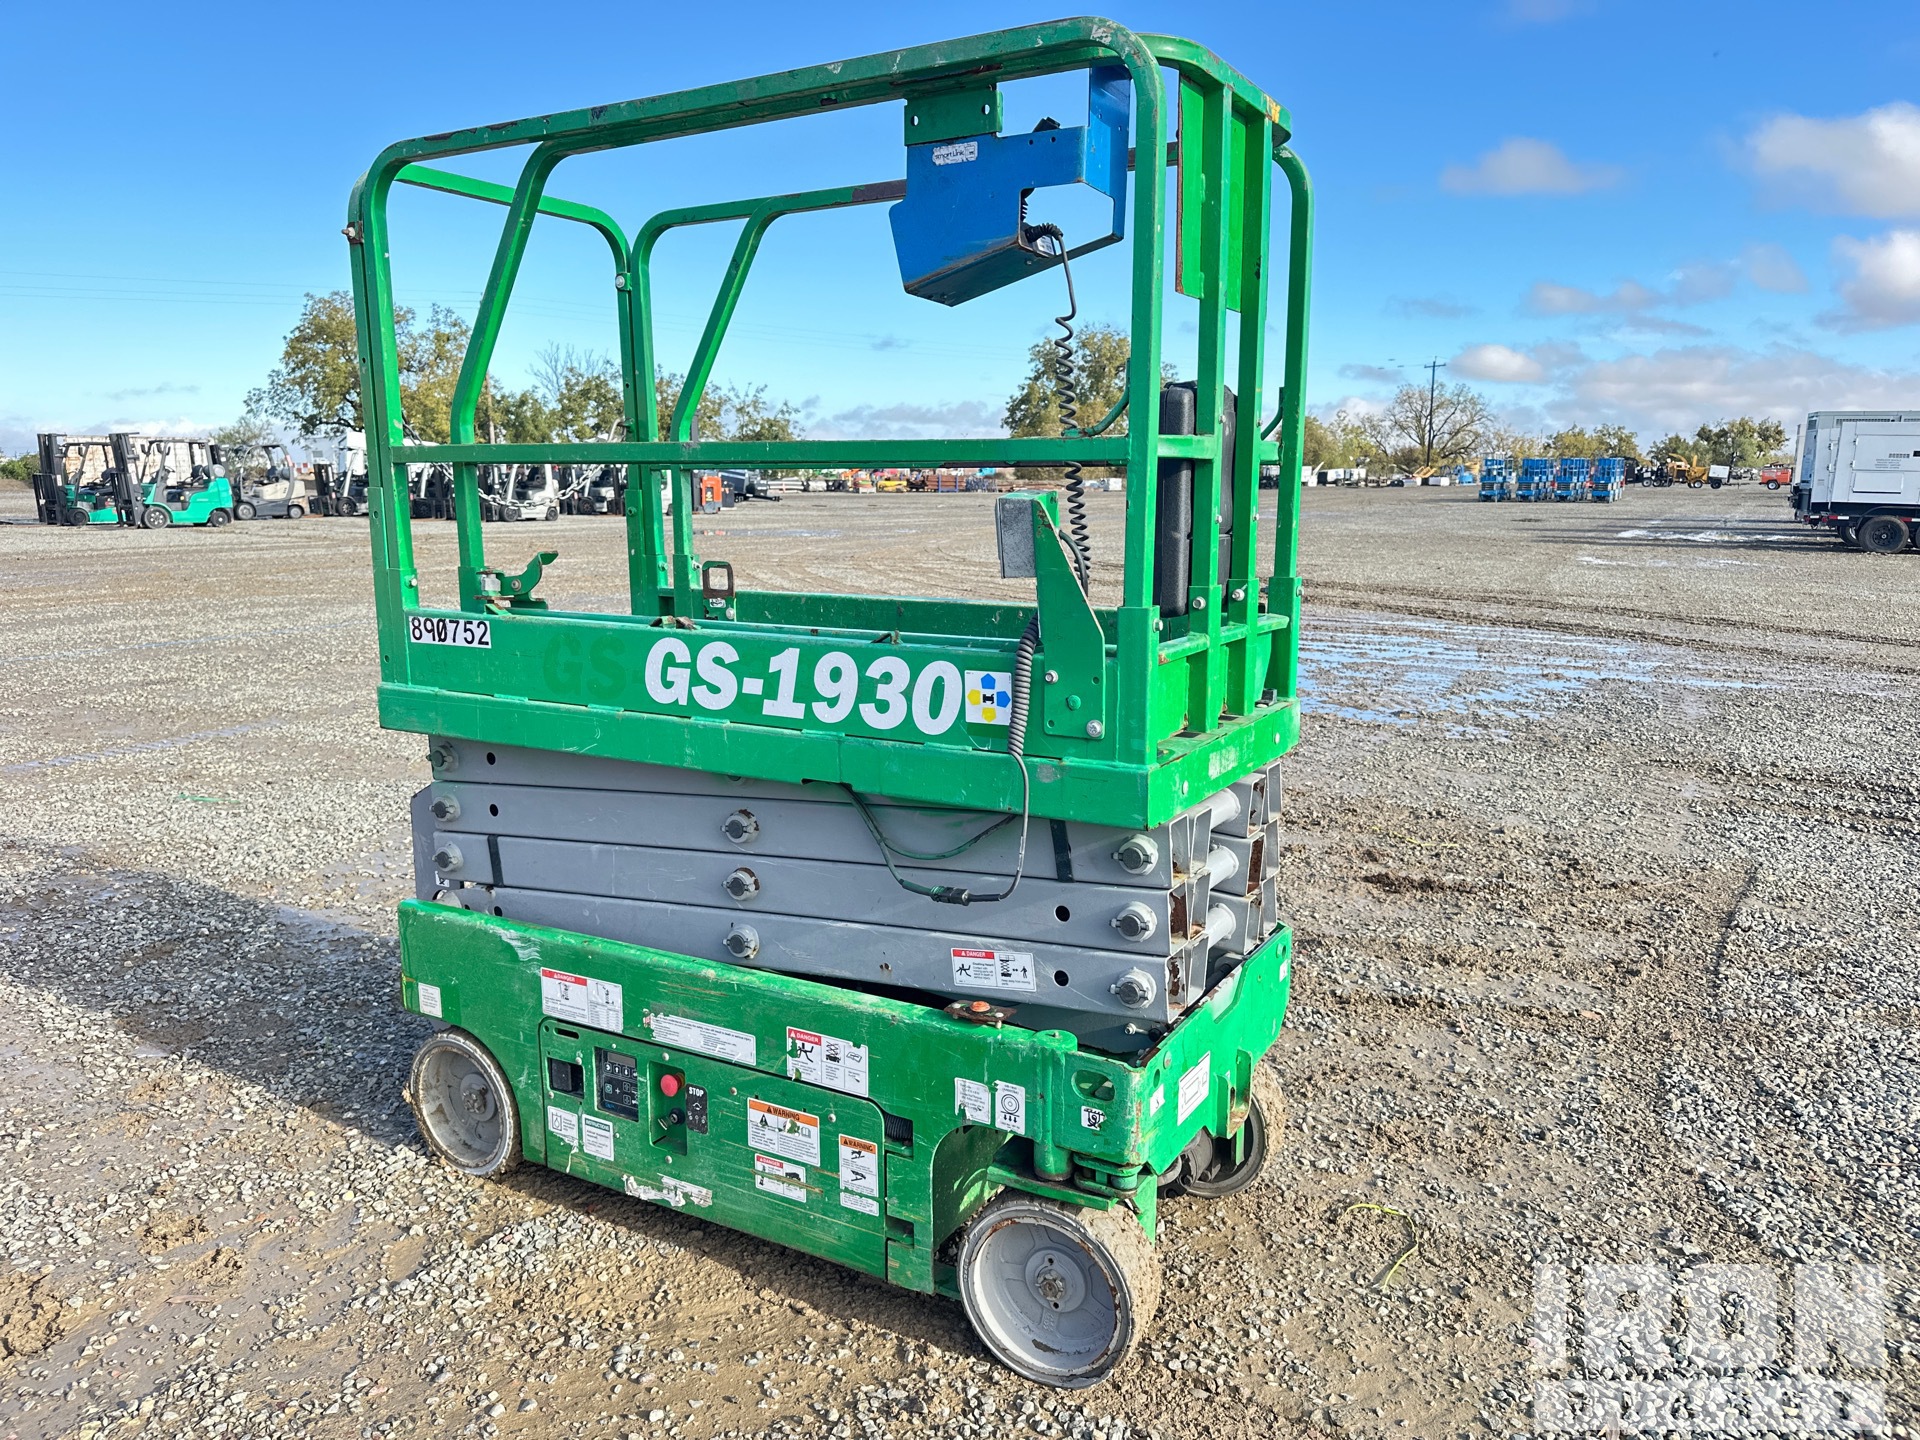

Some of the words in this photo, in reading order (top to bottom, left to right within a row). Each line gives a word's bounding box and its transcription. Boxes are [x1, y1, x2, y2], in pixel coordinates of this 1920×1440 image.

[412, 617, 490, 646] 890752
[645, 637, 962, 735] GS-1930
[966, 950, 986, 958] DANGER
[558, 973, 576, 983] DANGER
[796, 1032, 819, 1043] DANGER
[689, 1086, 704, 1097] STOP
[772, 1108, 800, 1121] WARNING
[847, 1138, 873, 1152] WARNING
[763, 1158, 781, 1168] DANGER
